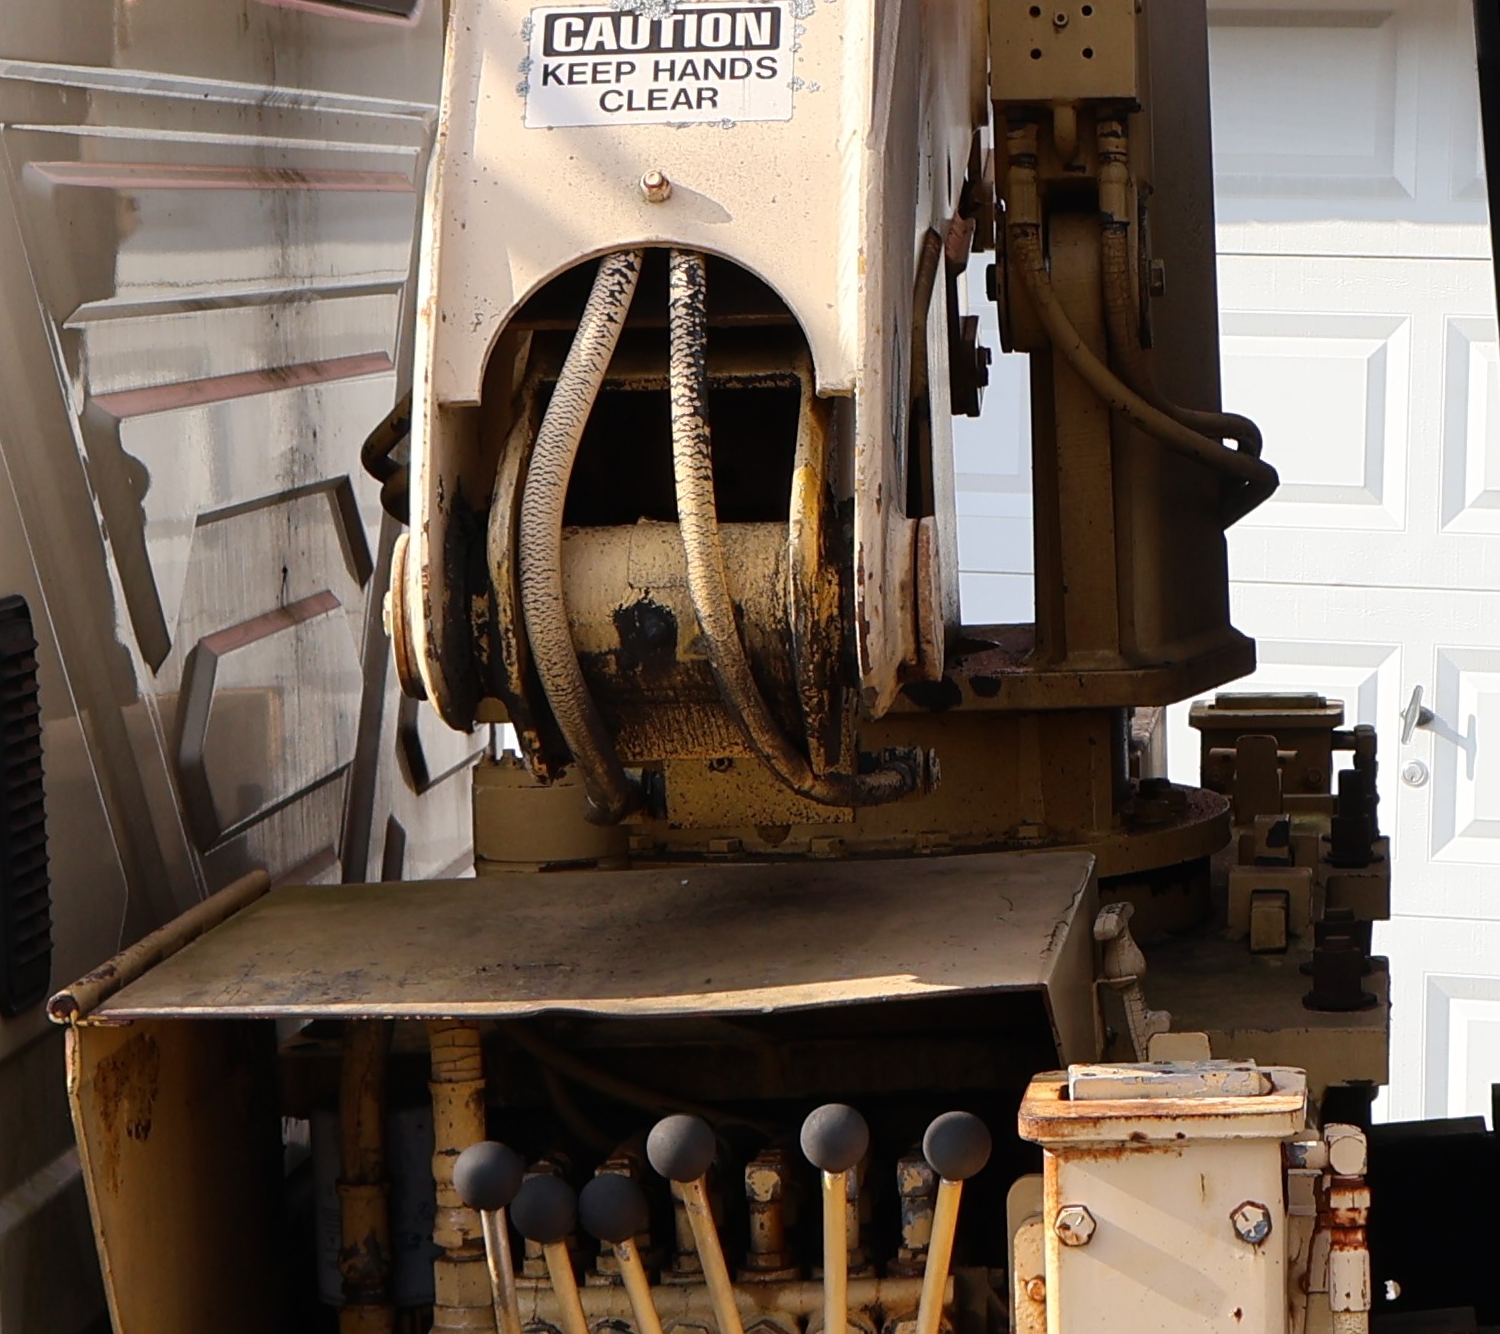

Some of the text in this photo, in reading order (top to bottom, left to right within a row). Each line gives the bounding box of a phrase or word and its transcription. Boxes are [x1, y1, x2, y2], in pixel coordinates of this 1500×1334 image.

[552, 12, 771, 52] CAUTION
[542, 55, 778, 86] KEEP HANDS
[599, 87, 719, 113] CLEAR
